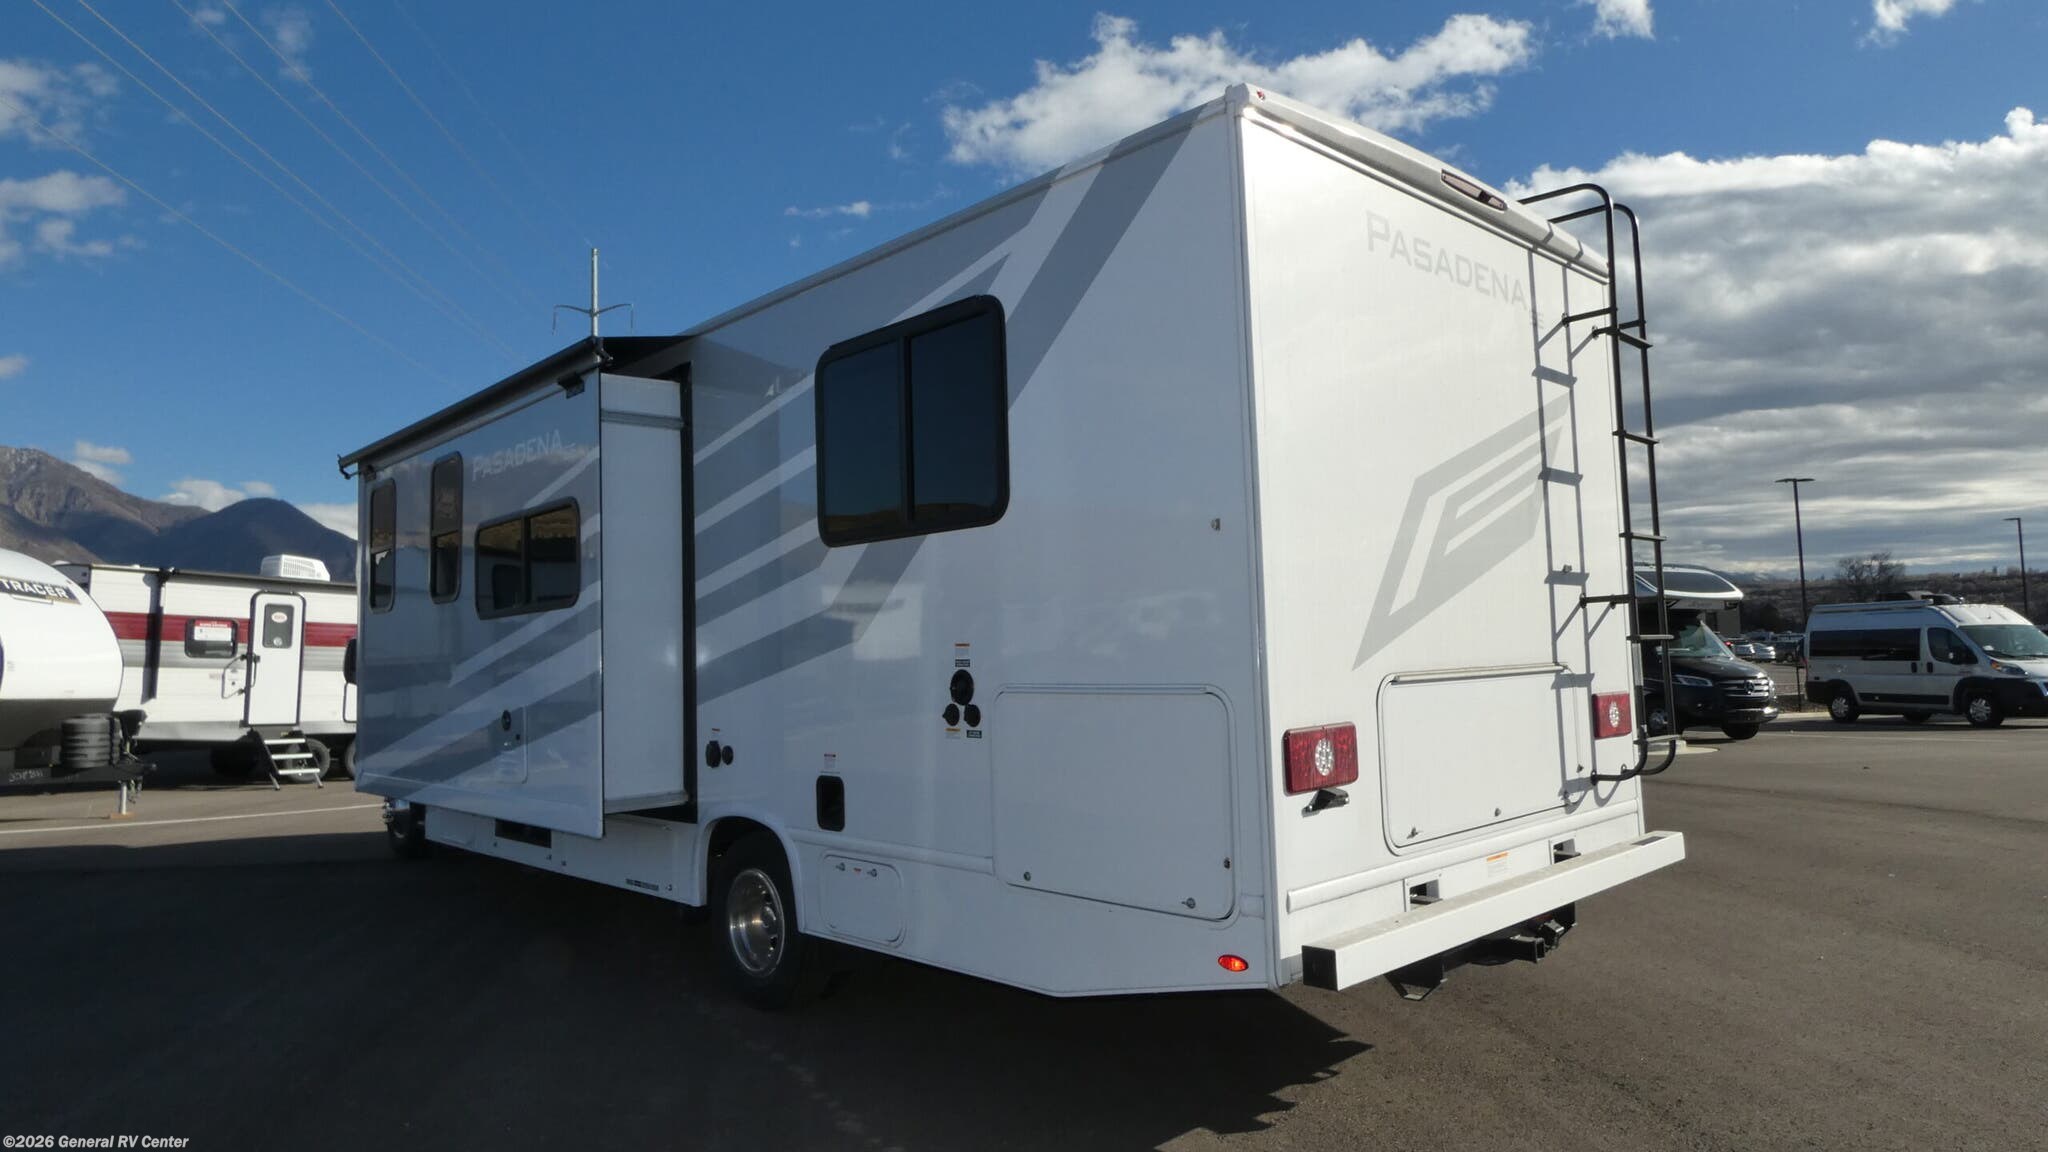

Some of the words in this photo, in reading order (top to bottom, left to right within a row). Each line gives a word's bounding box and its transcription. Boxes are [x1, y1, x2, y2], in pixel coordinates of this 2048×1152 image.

[1366, 210, 1527, 310] PASADENA
[472, 429, 562, 482] PASADENA
[1, 579, 69, 599] TRACER
